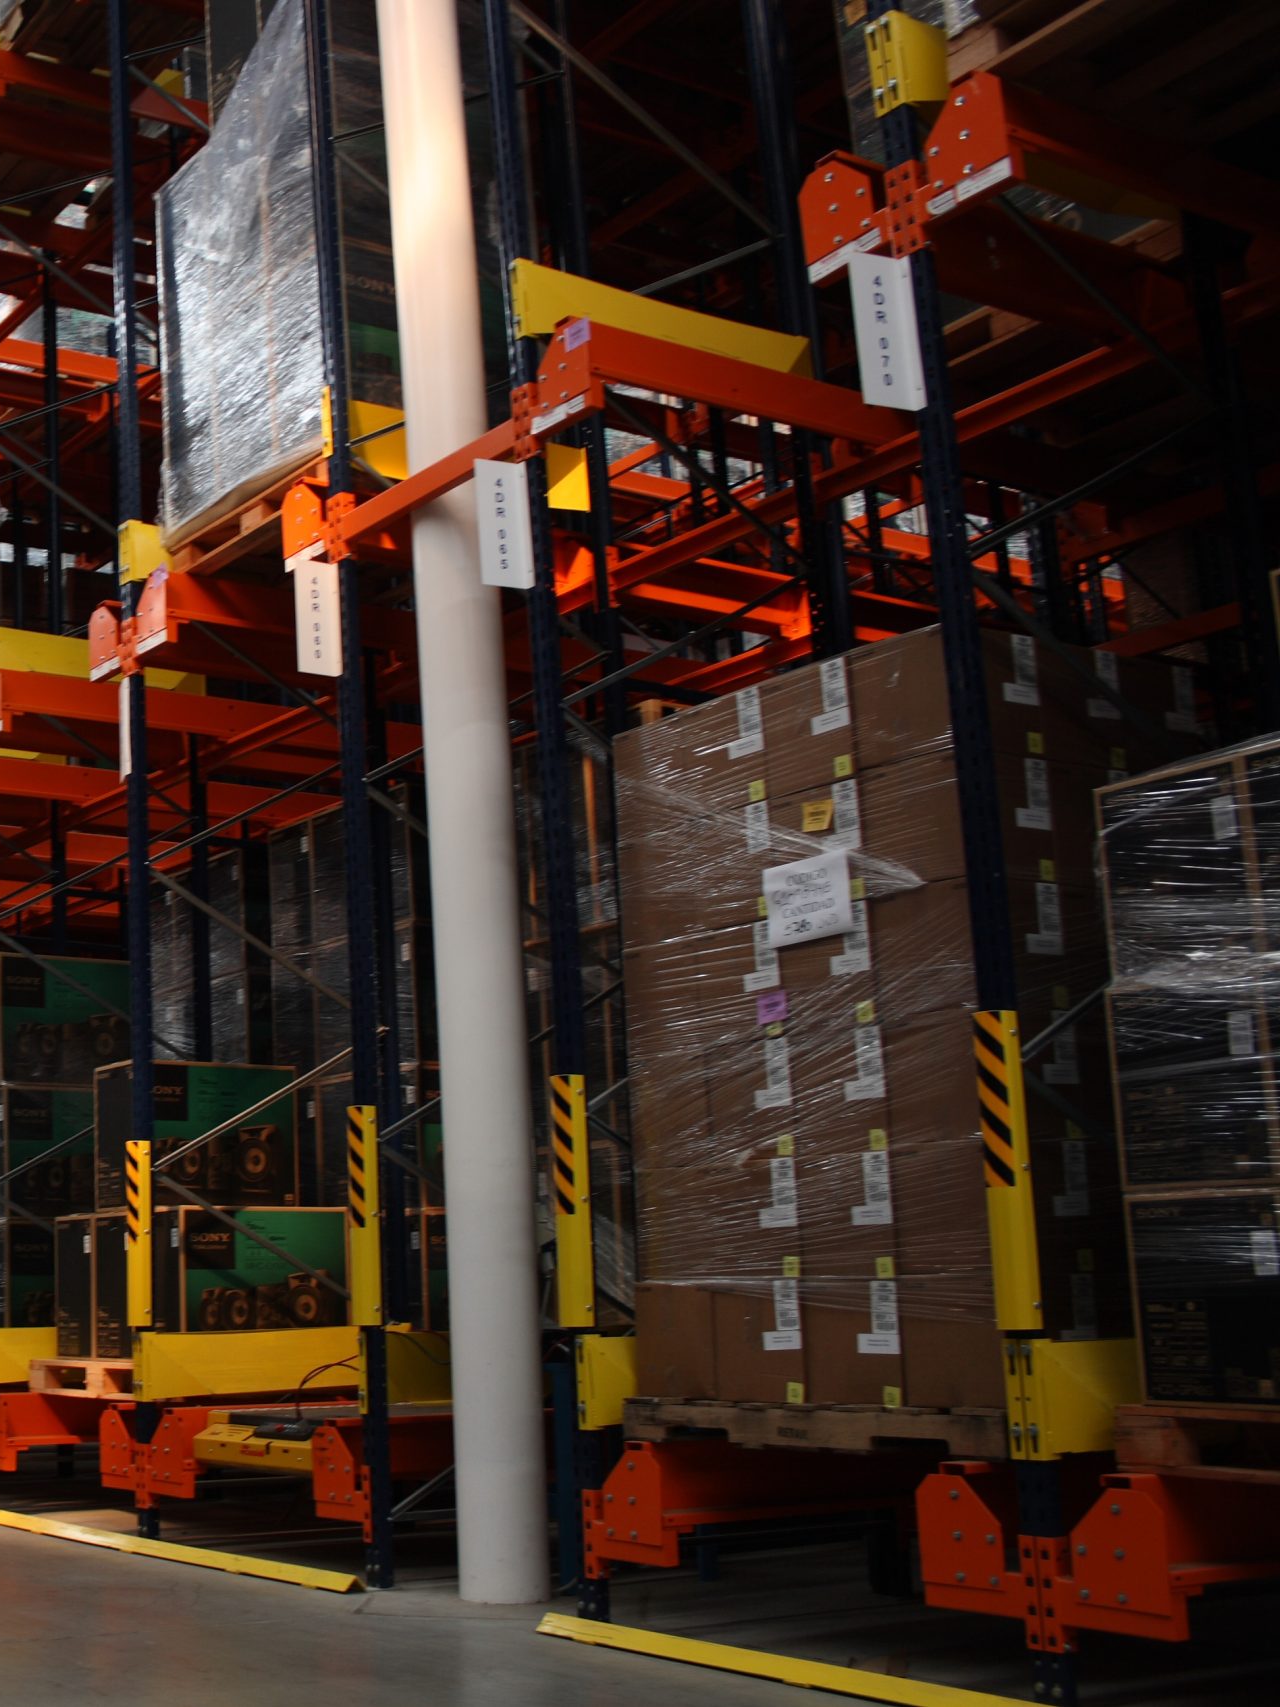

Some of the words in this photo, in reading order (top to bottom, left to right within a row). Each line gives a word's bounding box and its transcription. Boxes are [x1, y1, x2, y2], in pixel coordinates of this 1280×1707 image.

[872, 275, 888, 324] 4DR
[879, 337, 893, 386] 070
[494, 478, 506, 518] 4DR
[497, 529, 509, 570] 065
[311, 576, 320, 612] 4DR
[151, 1085, 185, 1095] ONY
[1135, 1207, 1185, 1218] SONY
[191, 1232, 232, 1242] SONY
